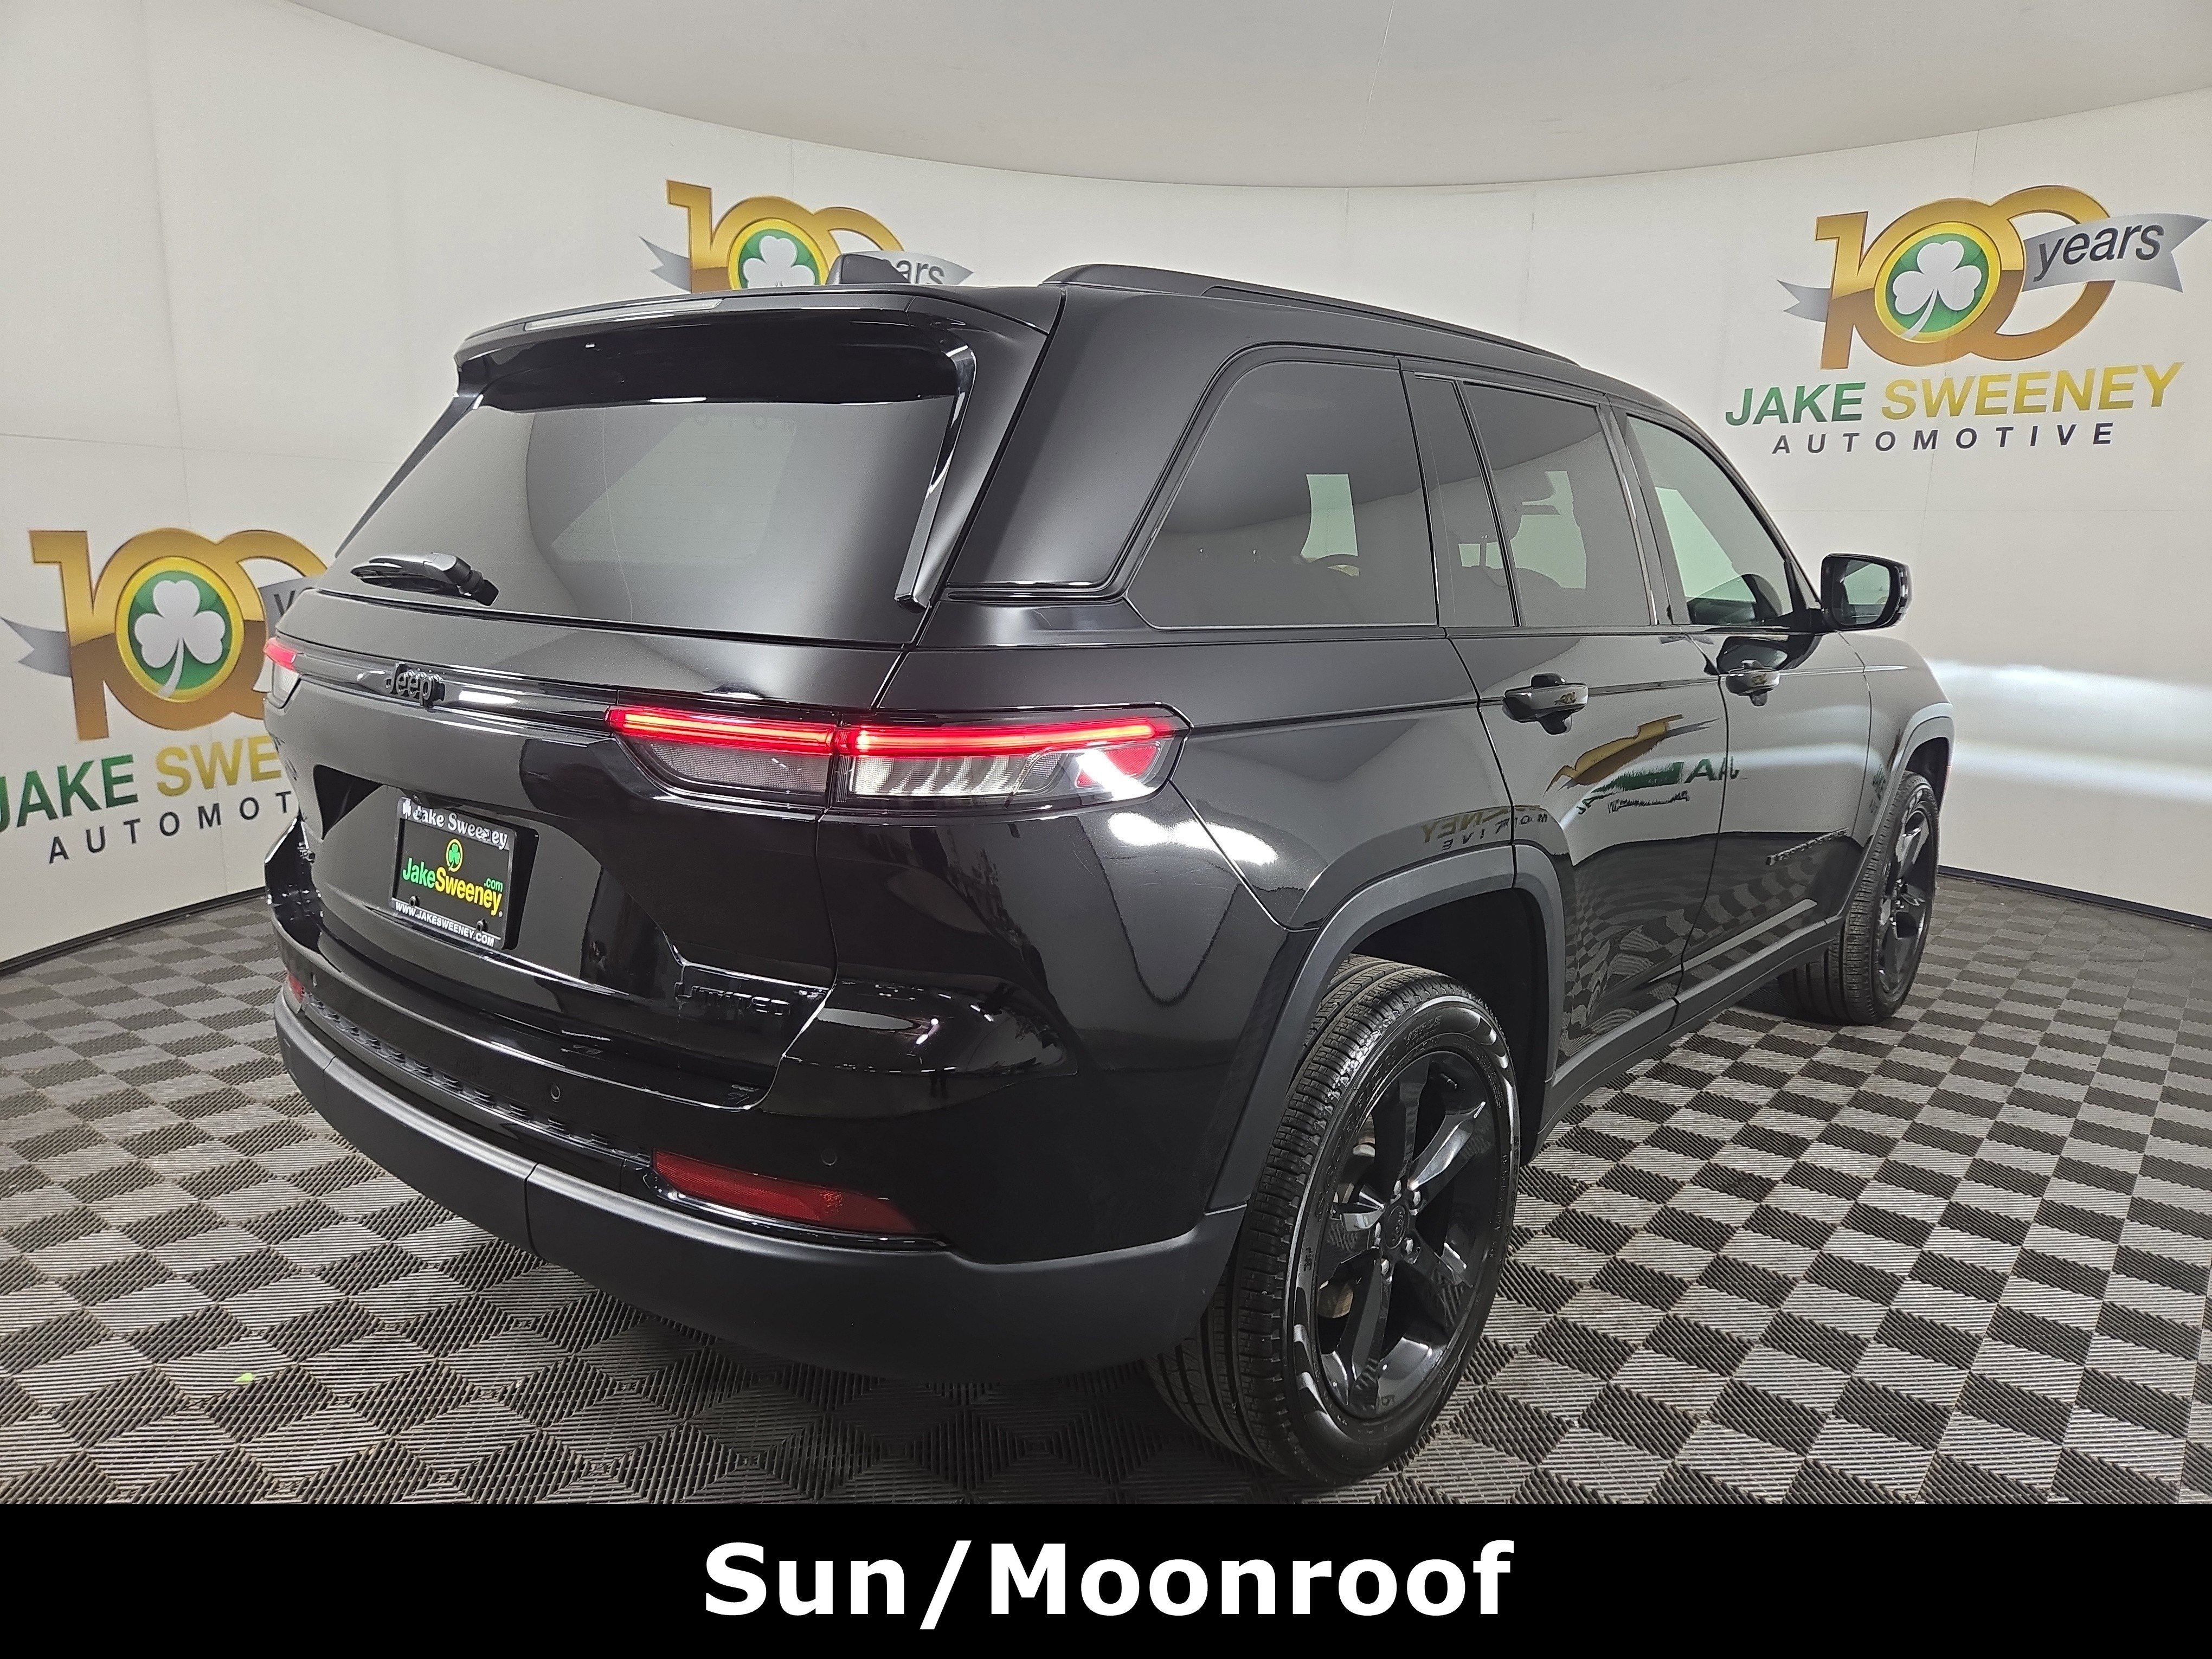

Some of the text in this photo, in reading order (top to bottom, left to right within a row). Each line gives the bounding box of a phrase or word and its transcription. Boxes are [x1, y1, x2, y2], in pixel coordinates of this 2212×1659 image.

[1815, 185, 2165, 370] 100 years
[1725, 361, 2186, 426] JAKE SWEENEY
[1771, 422, 2114, 455] AUTOMOTIVE
[384, 661, 440, 708] Jeep
[49, 790, 292, 864] AUTOMOT
[413, 805, 445, 828] Jake
[395, 902, 495, 947] WWW.JAKESWEENEY.COM
